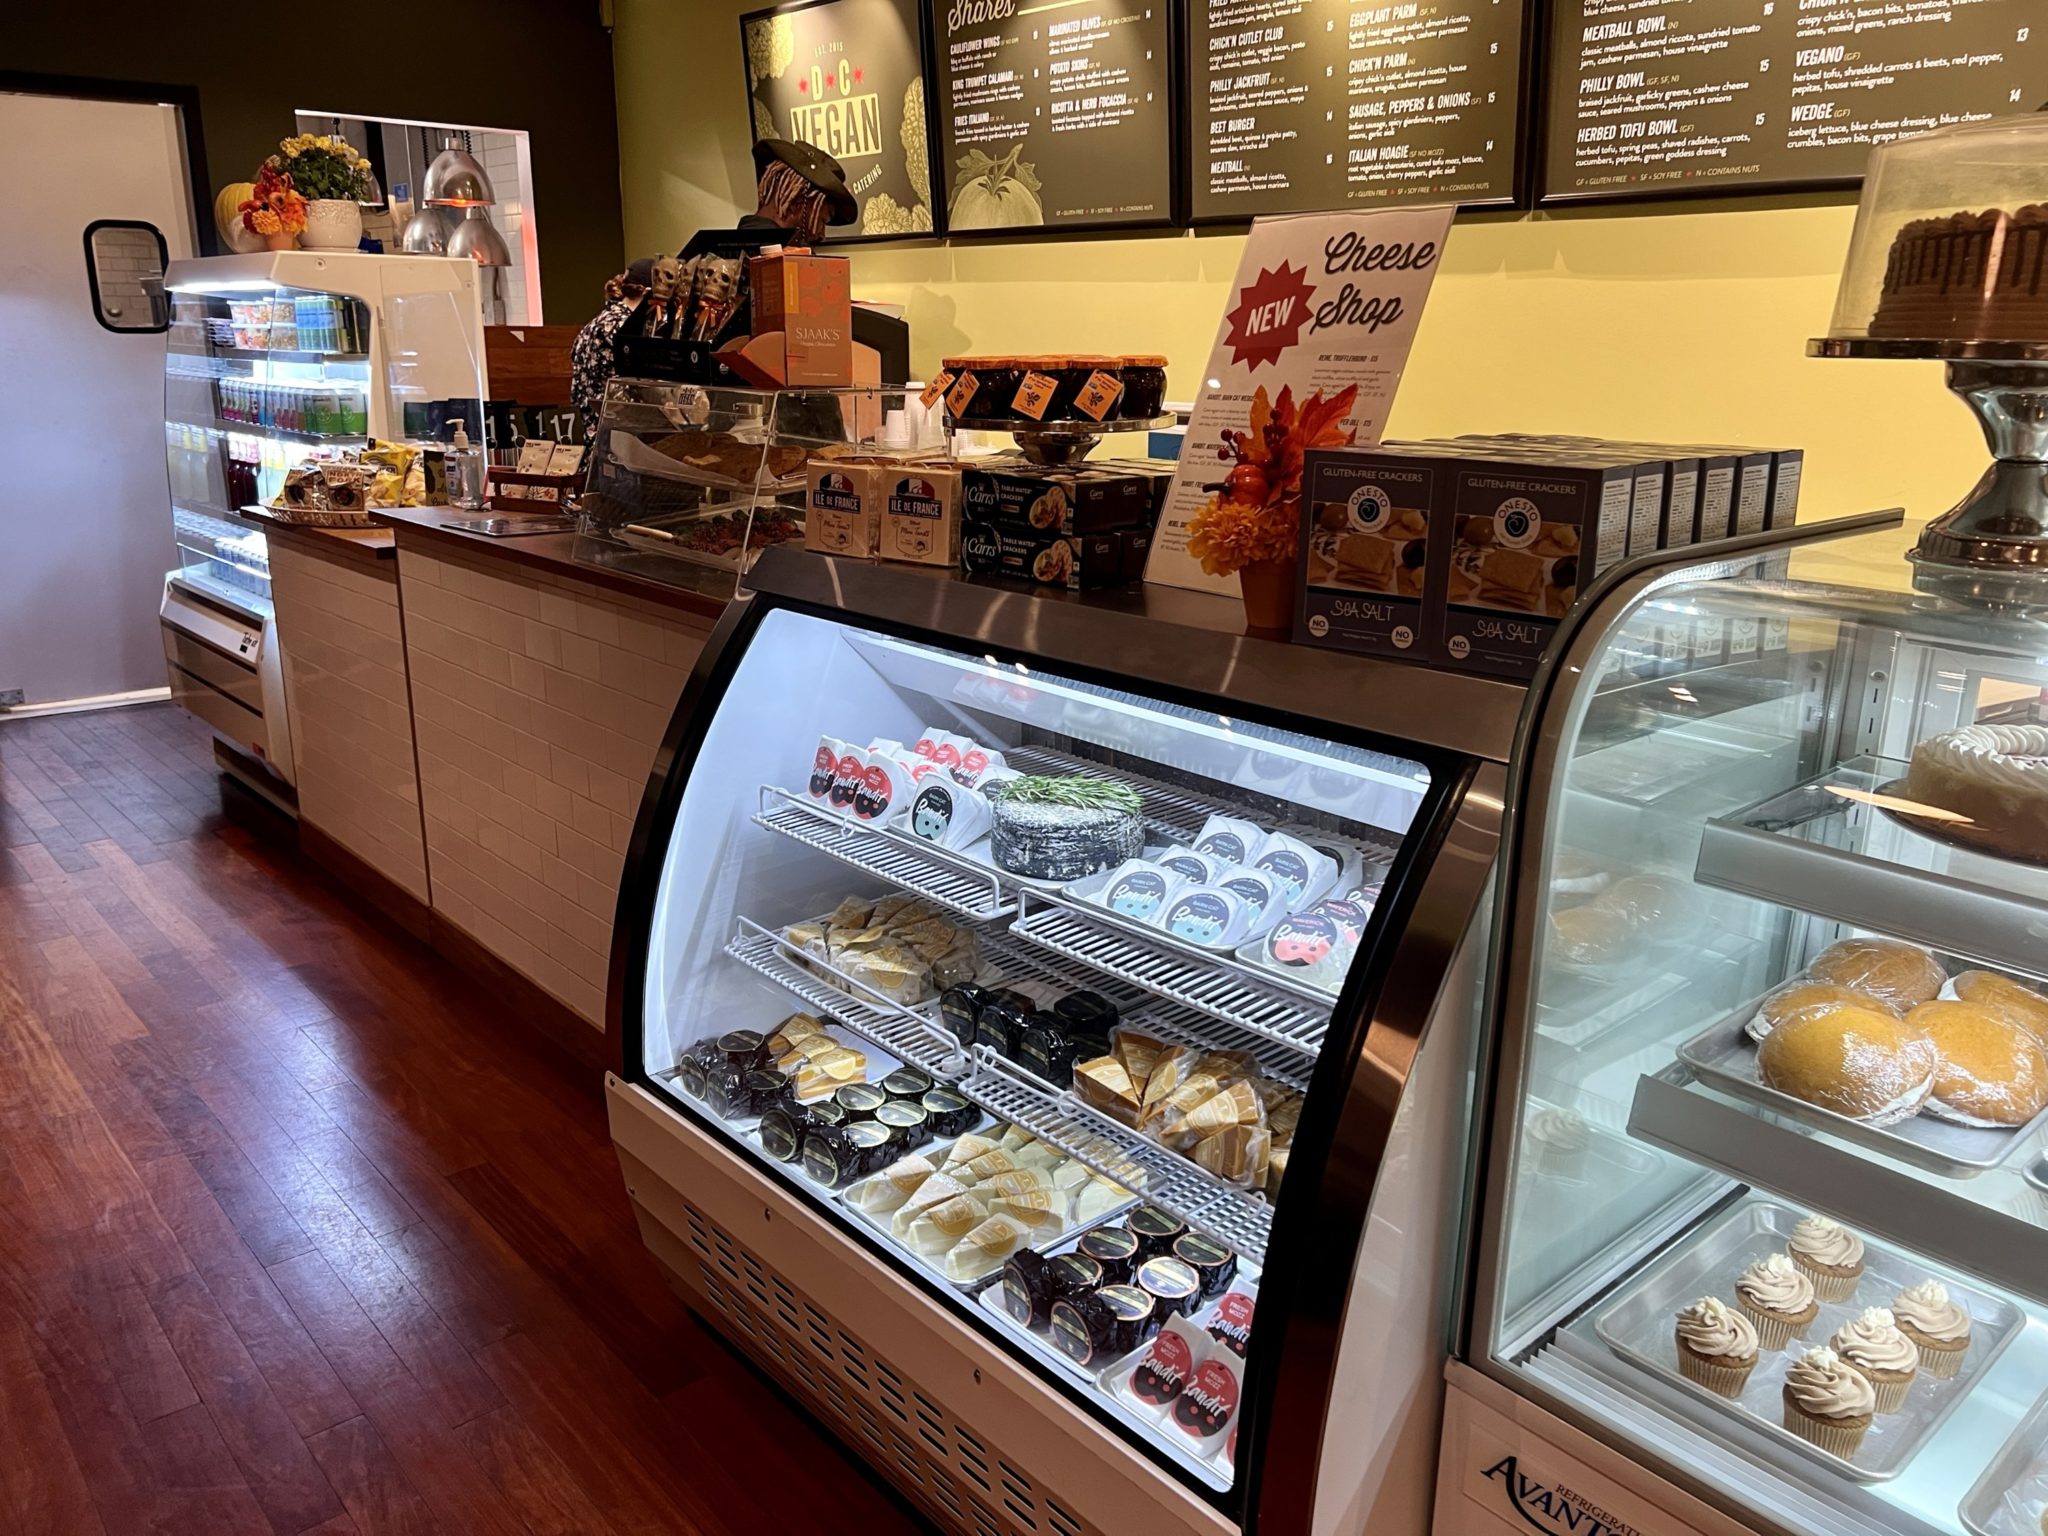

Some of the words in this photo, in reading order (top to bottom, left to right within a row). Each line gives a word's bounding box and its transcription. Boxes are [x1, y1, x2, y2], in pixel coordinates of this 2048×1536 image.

[948, 0, 1015, 38] Shares
[1350, 8, 1392, 28] EGGPLANT
[1392, 4, 1417, 20] PARM
[1914, 10, 1952, 22] dressing
[1238, 30, 1264, 46] CUTLET
[1265, 26, 1284, 41] CLUB
[1582, 21, 1632, 42] MEATBALL
[1636, 16, 1666, 34] BOWL
[2016, 28, 2029, 42] 13
[1490, 42, 1498, 54] 15
[1796, 46, 1844, 67] VEGANO
[1844, 52, 1860, 61] (GF)
[1348, 56, 1382, 74] CHICK'N
[1383, 52, 1408, 69] PARM
[1759, 58, 1770, 72] 15
[1844, 63, 1882, 76] shredded
[1884, 62, 1914, 72] carrots
[1914, 60, 1922, 68] &
[1952, 54, 1968, 65] red
[810, 64, 823, 101] D
[838, 58, 850, 96] C
[1210, 78, 1232, 93] PHILLY
[1234, 72, 1272, 90] JACKFRUIT
[1580, 74, 1612, 94] PHILLY
[1616, 72, 1645, 90] BOWL
[1693, 84, 1721, 95] cashew
[1722, 81, 1750, 90] cheese
[1824, 81, 1848, 90] house
[1850, 76, 1894, 90] vinaigrette
[1487, 92, 1496, 104] 15
[1668, 97, 1698, 111] peppers
[1706, 94, 1732, 104] onions
[2009, 88, 2021, 102] 14
[1348, 102, 1386, 119] SAUSAGE,
[1388, 98, 1426, 116] PEPPERS
[1426, 96, 1435, 110] &
[1437, 92, 1472, 109] ONIONS
[1791, 102, 1834, 122] WEDGE
[1834, 109, 1850, 118] (GF)
[792, 97, 880, 157] VEGAN
[1210, 121, 1228, 134] BEET
[1228, 117, 1256, 132] BURGER
[1756, 113, 1766, 126] 15
[1850, 122, 1868, 132] blue
[1870, 120, 1899, 130] cheese
[1940, 113, 1959, 124] blue
[1577, 125, 1616, 144] HERBED
[1620, 122, 1646, 139] TOFU
[1648, 119, 1678, 136] BOWL
[1680, 124, 1694, 133] (GF)
[1348, 148, 1378, 163] ITALIAN
[1380, 145, 1410, 161] HOAGIE
[1486, 140, 1494, 152] 14
[1211, 160, 1243, 174] MEATBALL
[1742, 164, 1760, 173] NUTS
[852, 164, 882, 195] CATERING
[1325, 231, 1436, 275] Cheese
[1245, 296, 1296, 337] NEW
[1309, 283, 1404, 335] Shop
[796, 328, 840, 340] SJAAK'S
[1322, 468, 1376, 479] GLUTEN-FREE
[1378, 472, 1422, 482] CRACKERS
[1468, 478, 1526, 491] GLUTEN-FREE
[1528, 483, 1576, 494] CRACKERS
[834, 496, 859, 511] FRANCE
[1351, 488, 1388, 508] ONESTO
[912, 502, 939, 516] FRANCE
[1498, 500, 1538, 522] ONESTO
[1361, 602, 1394, 622] SALT
[1312, 620, 1326, 628] NO
[1396, 630, 1410, 640] NO
[1505, 624, 1542, 644] SALT
[1452, 640, 1466, 650] NO
[857, 779, 888, 804] Bandit
[1112, 884, 1161, 905] Bandit
[1172, 906, 1224, 928] Bandit
[1273, 924, 1332, 945] Bandit
[1228, 1307, 1246, 1320] MOZZ
[1230, 1302, 1249, 1314] FRESH
[1160, 1346, 1176, 1360] MOZZ
[1162, 1340, 1180, 1354] FRESH
[1140, 1348, 1186, 1384] Bandit
[1204, 1376, 1222, 1390] MOZZ
[1206, 1370, 1225, 1385] FRESH
[1182, 1374, 1232, 1417] Bandit
[1480, 1456, 1623, 1536] AVANT
